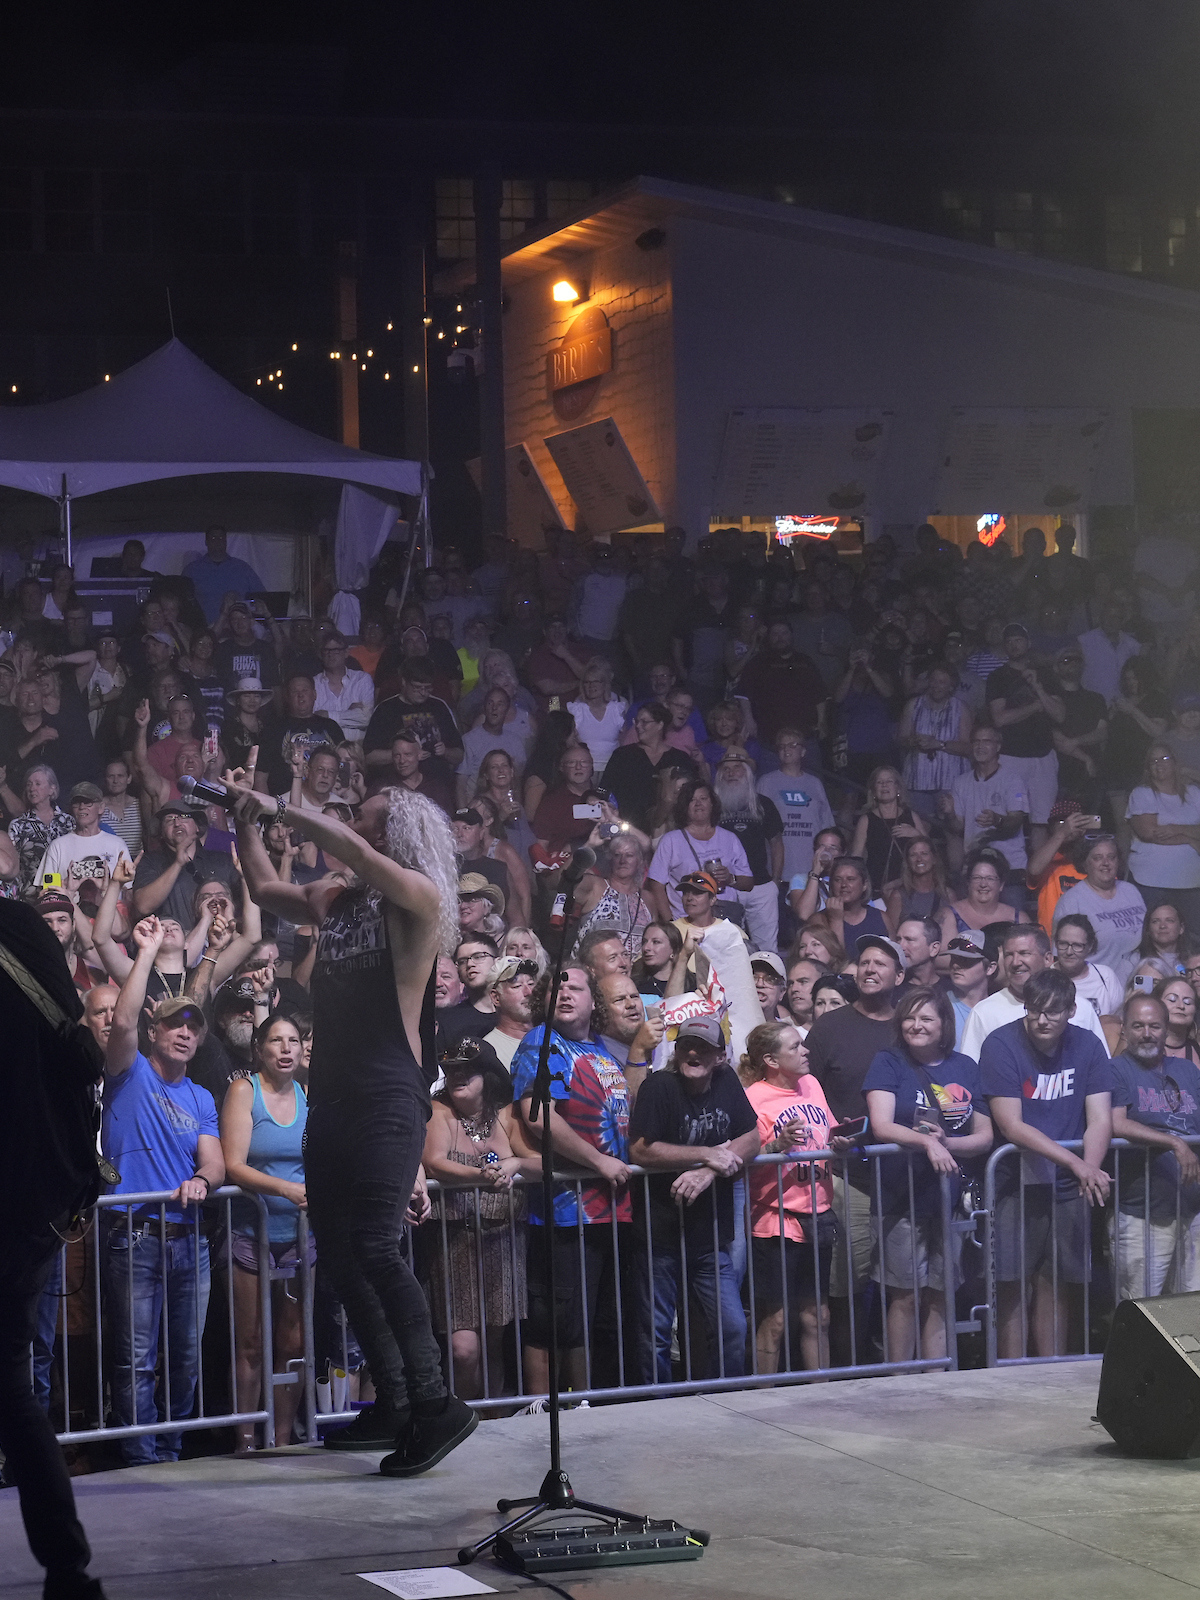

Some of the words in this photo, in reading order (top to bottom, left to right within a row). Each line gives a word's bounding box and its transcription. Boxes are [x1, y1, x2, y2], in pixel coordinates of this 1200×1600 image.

[775, 519, 838, 534] Budweiser
[233, 662, 256, 671] IOWA
[785, 792, 805, 802] IA
[1096, 906, 1145, 922] NORTHERN
[1112, 916, 1144, 928] IOWA
[340, 952, 382, 975] CONTENT
[1031, 1068, 1075, 1101] NIKE
[797, 1103, 831, 1127] YOR
